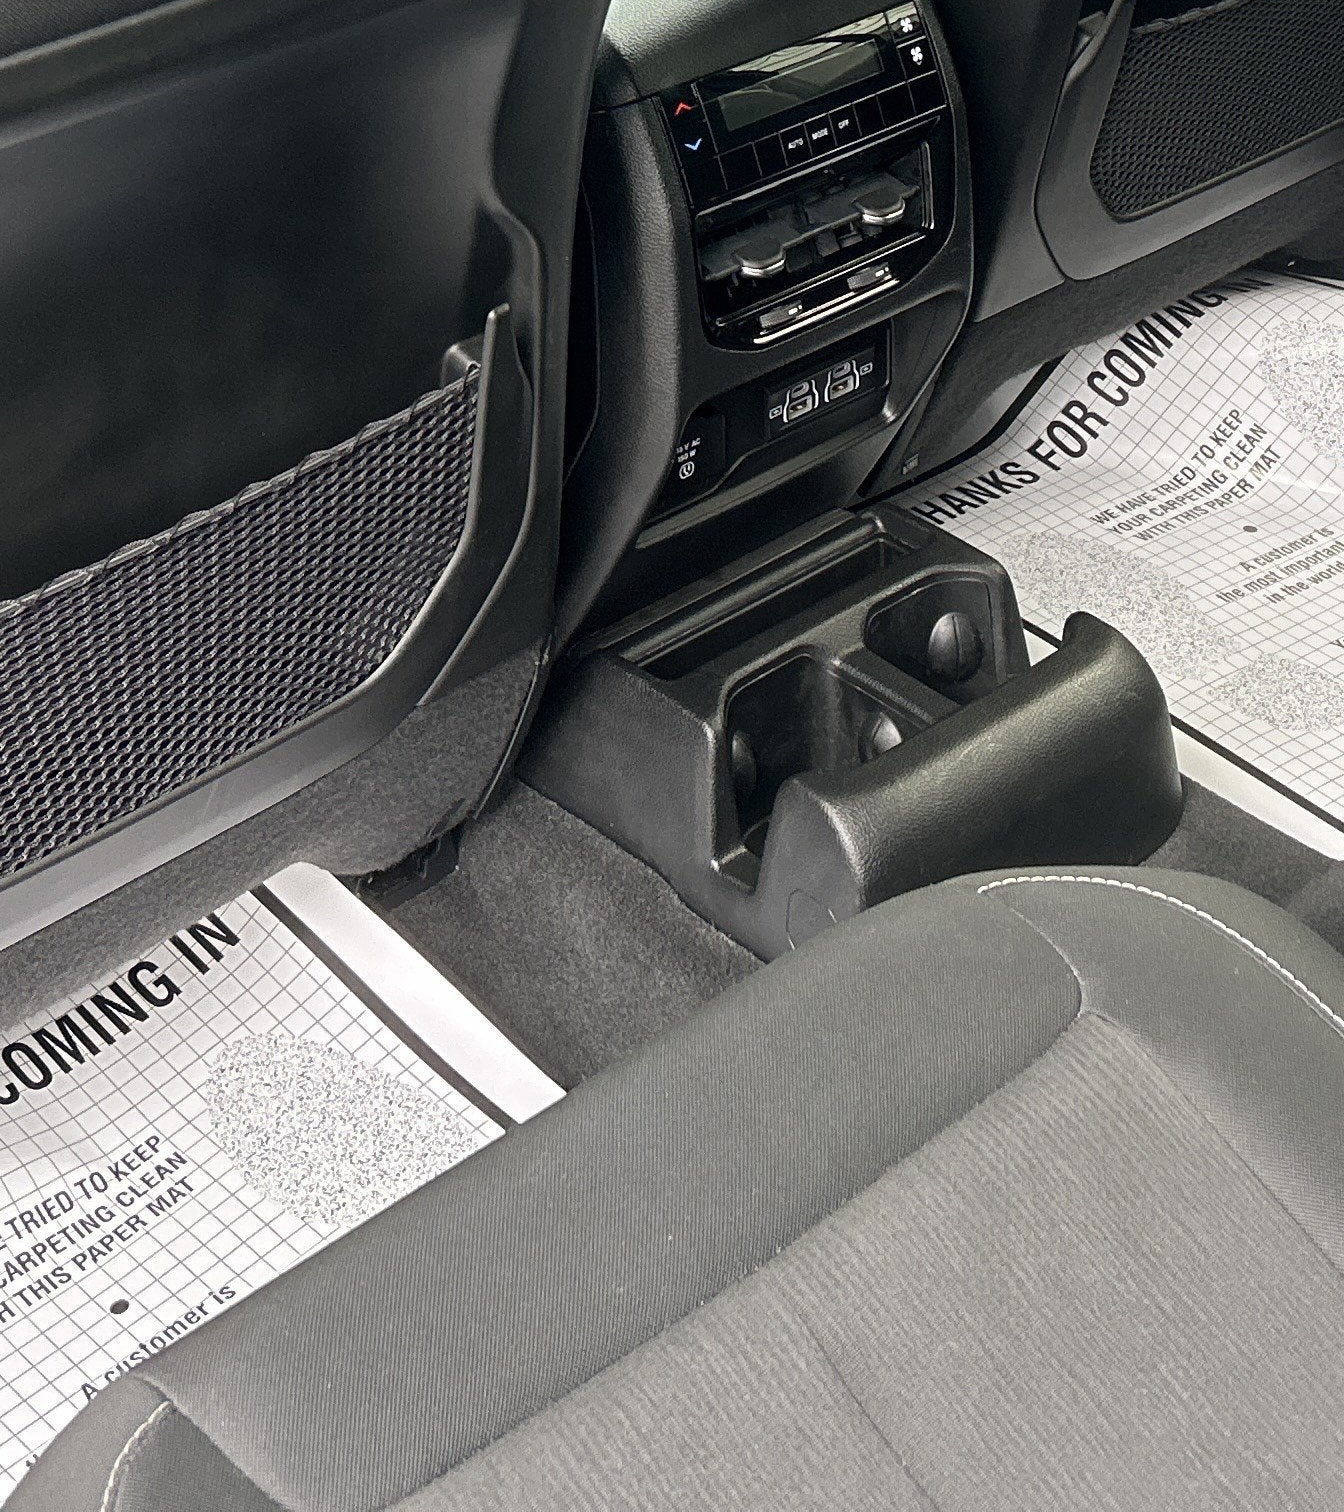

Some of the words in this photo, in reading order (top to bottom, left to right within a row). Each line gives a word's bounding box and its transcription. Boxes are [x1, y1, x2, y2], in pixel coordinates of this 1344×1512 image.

[911, 461, 1040, 525] HANKS
[1026, 400, 1109, 471] FOR
[1087, 289, 1229, 407] COMING
[1090, 508, 1118, 525] WE
[1115, 491, 1157, 514] HAVE
[1152, 465, 1197, 496] TRIED
[1191, 444, 1216, 467] TO
[1209, 409, 1243, 448] KEEP
[1108, 513, 1153, 535] YOUR
[1149, 469, 1229, 517] CARPETING
[1223, 423, 1268, 471] CLEAN
[1132, 521, 1177, 541] WITH
[1173, 505, 1210, 525] THIS
[1205, 478, 1254, 511] PAPER
[1249, 445, 1281, 481] MAT
[1216, 587, 1245, 603] the
[1243, 570, 1283, 593] most
[1239, 560, 1257, 573] A
[1256, 529, 1319, 566] customer
[1316, 527, 1335, 538] is
[1264, 592, 1286, 604] in
[1280, 581, 1310, 597] the
[170, 913, 241, 975] IN
[4, 1190, 74, 1240] TRIED
[73, 1171, 109, 1200] TO
[107, 1135, 162, 1183] KEEP
[115, 1151, 188, 1208] CLEAN
[13, 1265, 73, 1307] THIS
[71, 1214, 148, 1271] PAPER
[145, 1176, 198, 1218] MAT
[81, 1382, 98, 1402] A
[104, 1302, 209, 1382] customer
[208, 1285, 236, 1306] is
